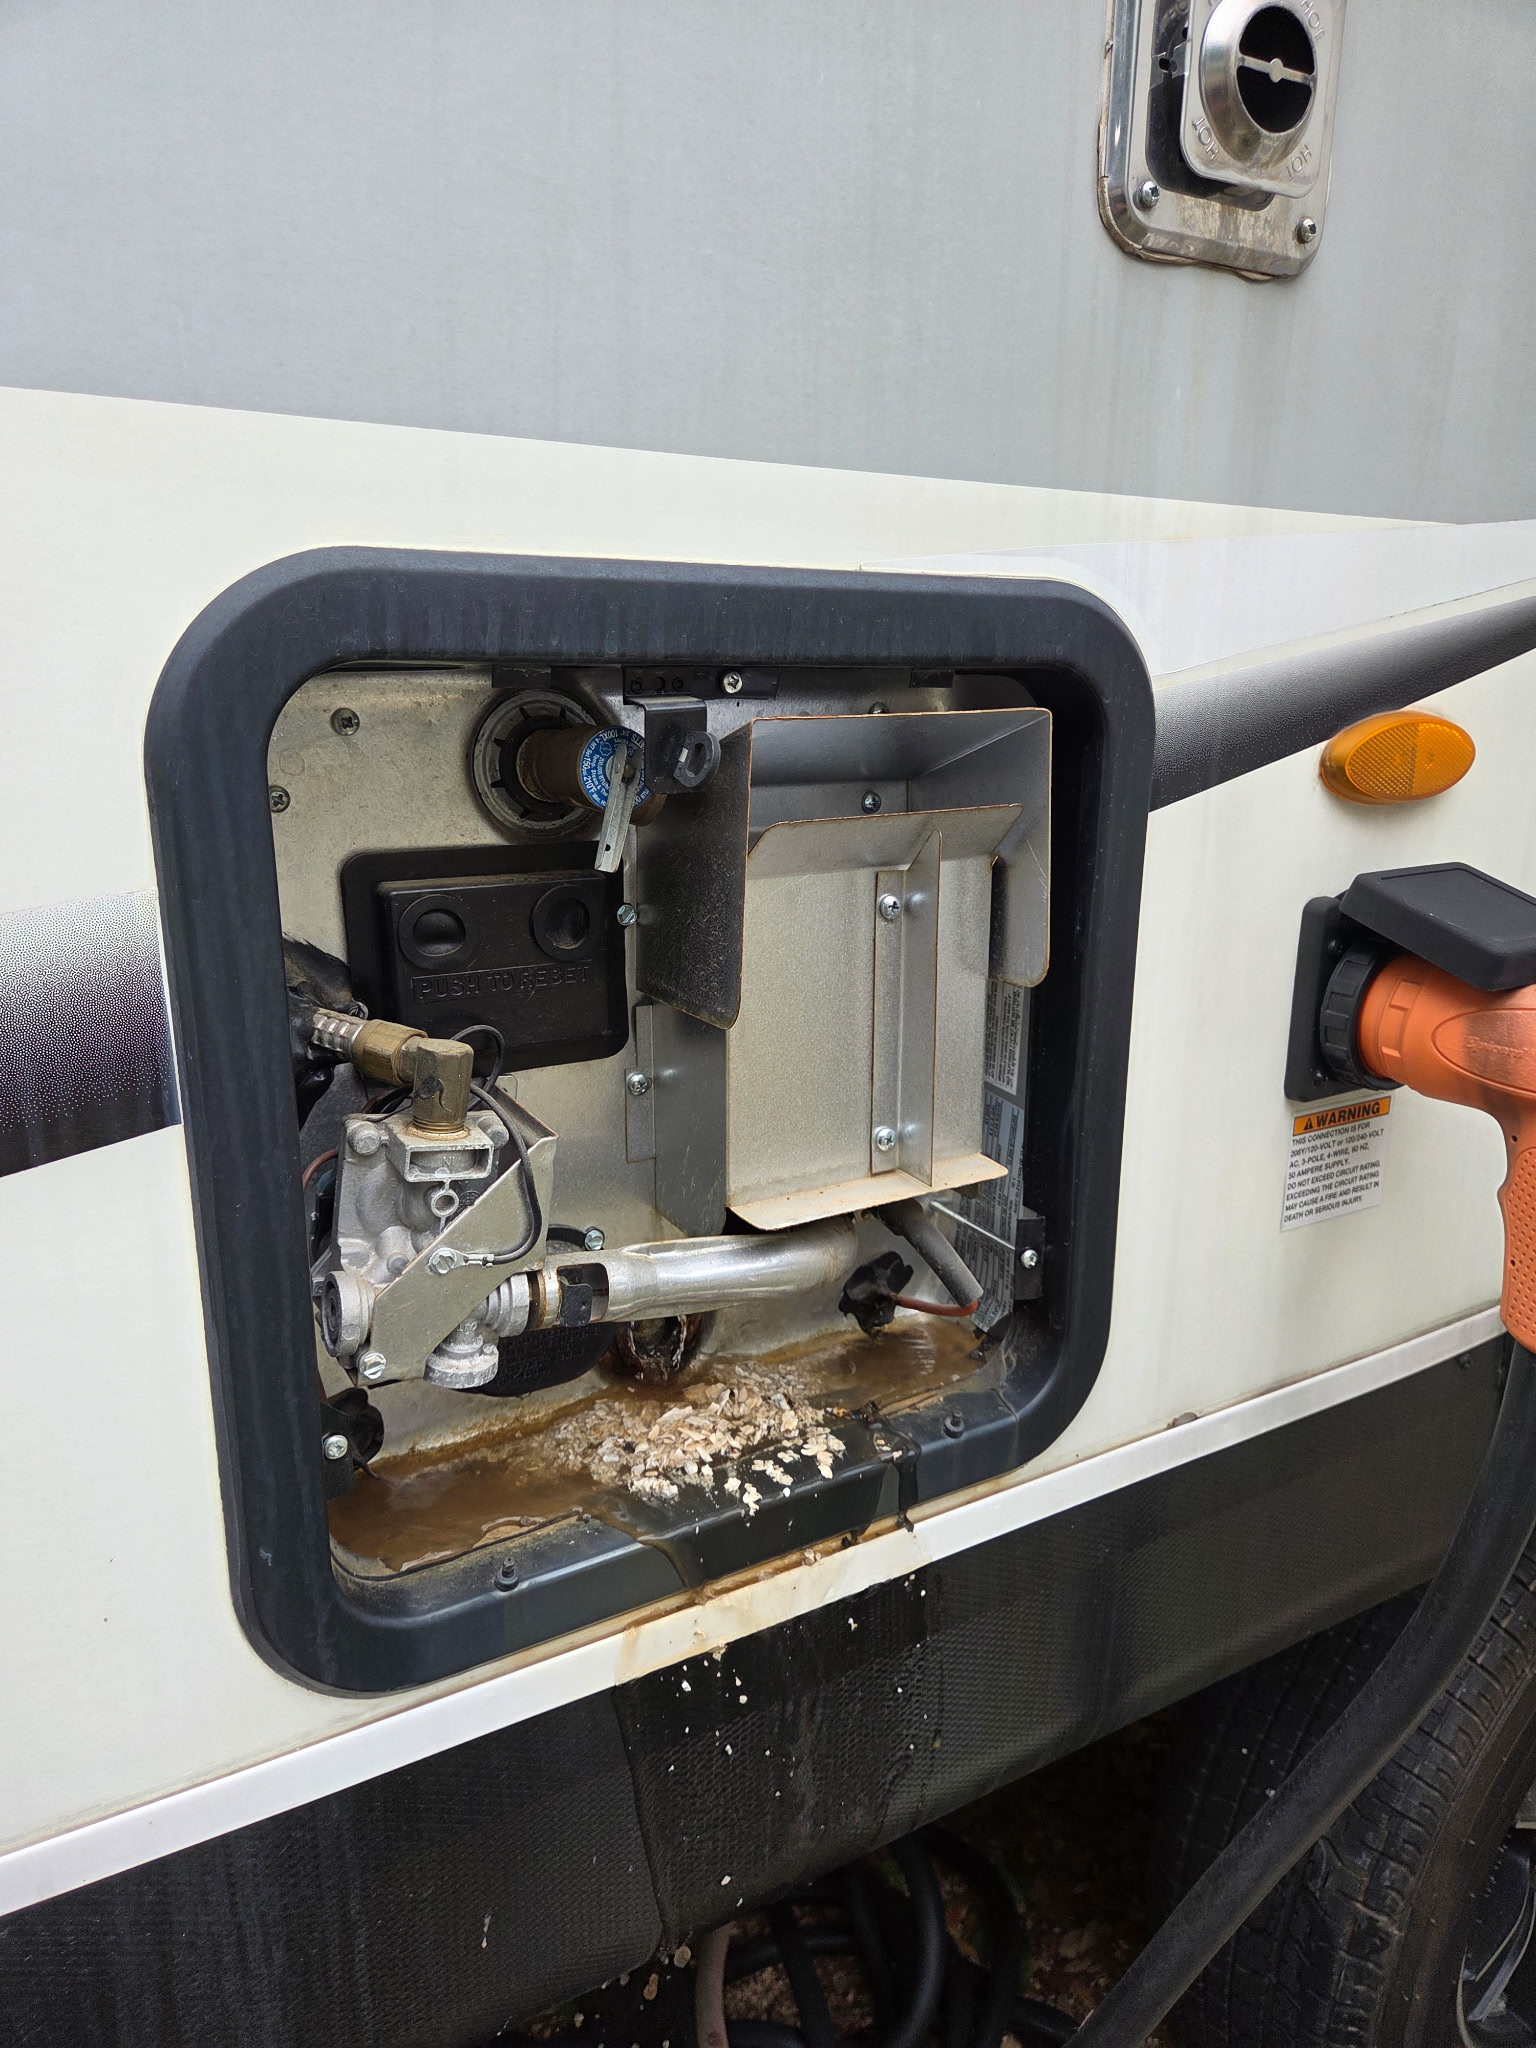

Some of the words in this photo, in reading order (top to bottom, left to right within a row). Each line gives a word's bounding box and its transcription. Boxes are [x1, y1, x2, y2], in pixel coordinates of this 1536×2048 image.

[1192, 118, 1219, 161] HOT
[1287, 143, 1312, 180] HOT
[420, 974, 480, 999] PUSH
[488, 974, 512, 992] TO
[520, 966, 589, 991] RESET
[1316, 1102, 1380, 1127] WARNING
[1292, 1136, 1306, 1146] THIS
[1308, 1127, 1349, 1143] CONNECTION
[1358, 1122, 1370, 1131] FOR
[1288, 1182, 1296, 1190] DO
[1298, 1179, 1310, 1187] NOT
[1311, 1172, 1334, 1185] EXCEED
[1336, 1165, 1358, 1178] CIRCUIT
[1297, 1163, 1322, 1178] AMPERE
[1285, 1203, 1297, 1211] MAY
[1300, 1197, 1318, 1209] CAUSE
[1319, 1195, 1324, 1203] A
[1325, 1191, 1337, 1200] FIRE
[1339, 1188, 1350, 1197] AND
[1352, 1182, 1372, 1194] RESULT
[1286, 1186, 1320, 1201] EXCEEDING
[1322, 1181, 1333, 1191] THE
[1335, 1176, 1357, 1188] CIRCUIT
[1284, 1212, 1303, 1222] DEATH
[1305, 1208, 1313, 1216] OR
[1315, 1202, 1340, 1214] SERIOUS
